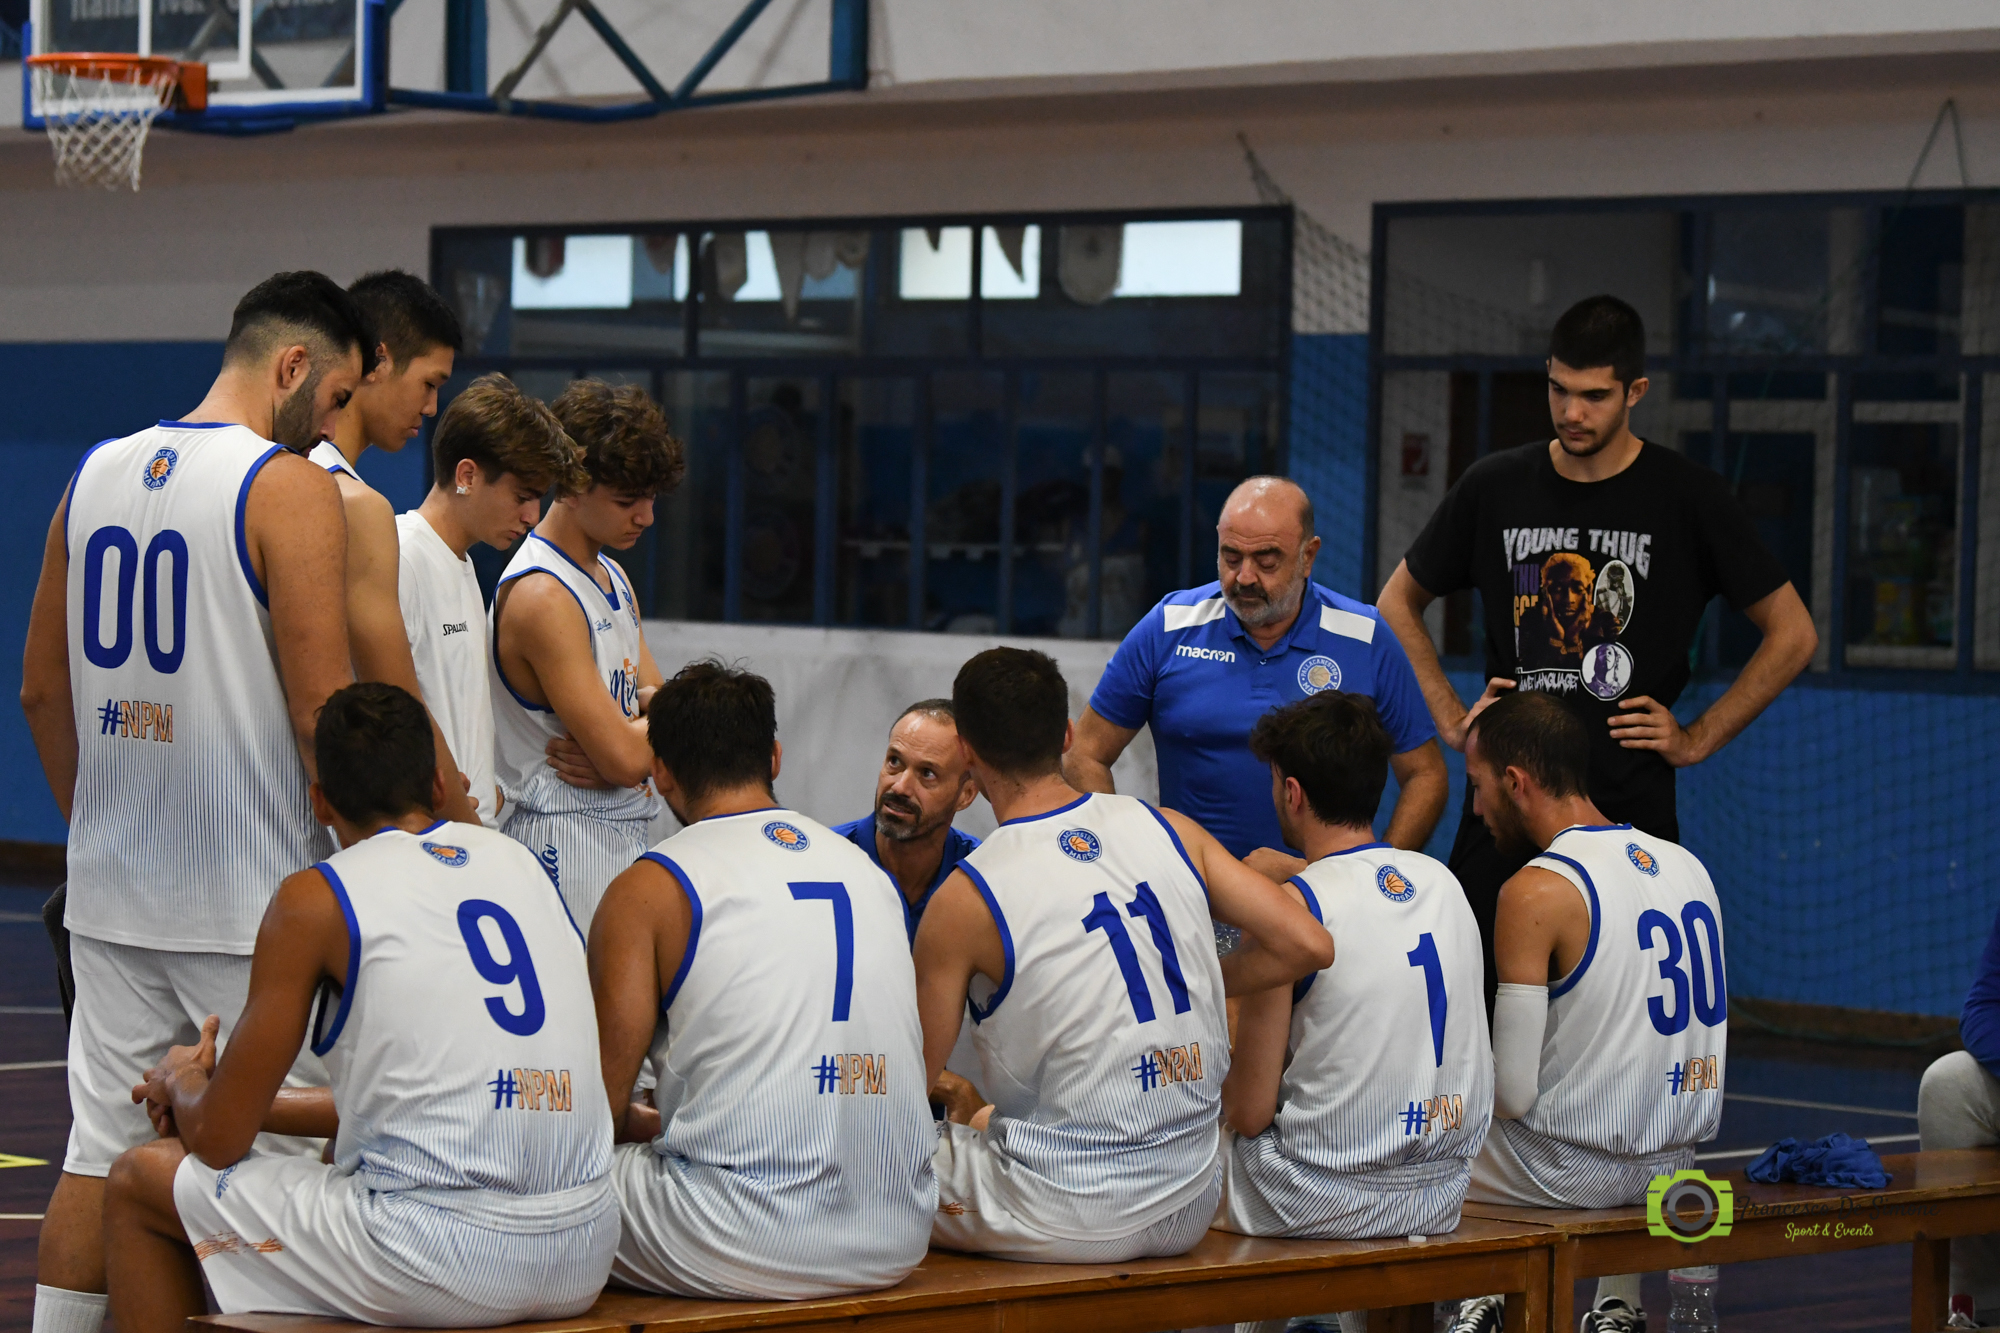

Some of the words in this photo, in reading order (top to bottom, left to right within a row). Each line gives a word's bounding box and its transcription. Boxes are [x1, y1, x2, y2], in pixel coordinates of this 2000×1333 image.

[83, 525, 189, 674] 00
[1503, 527, 1579, 572] YOUNG
[1588, 529, 1652, 580] THUG
[1175, 644, 1236, 663] macron
[97, 699, 173, 743] #NPM
[457, 899, 545, 1036] 9
[787, 881, 854, 1022] 7
[1081, 881, 1191, 1024] 11
[1637, 900, 1727, 1036] 30
[1406, 932, 1447, 1068] 1
[487, 1067, 572, 1112] #NPM
[811, 1053, 887, 1095] #NPM
[1131, 1042, 1203, 1093] #NPM
